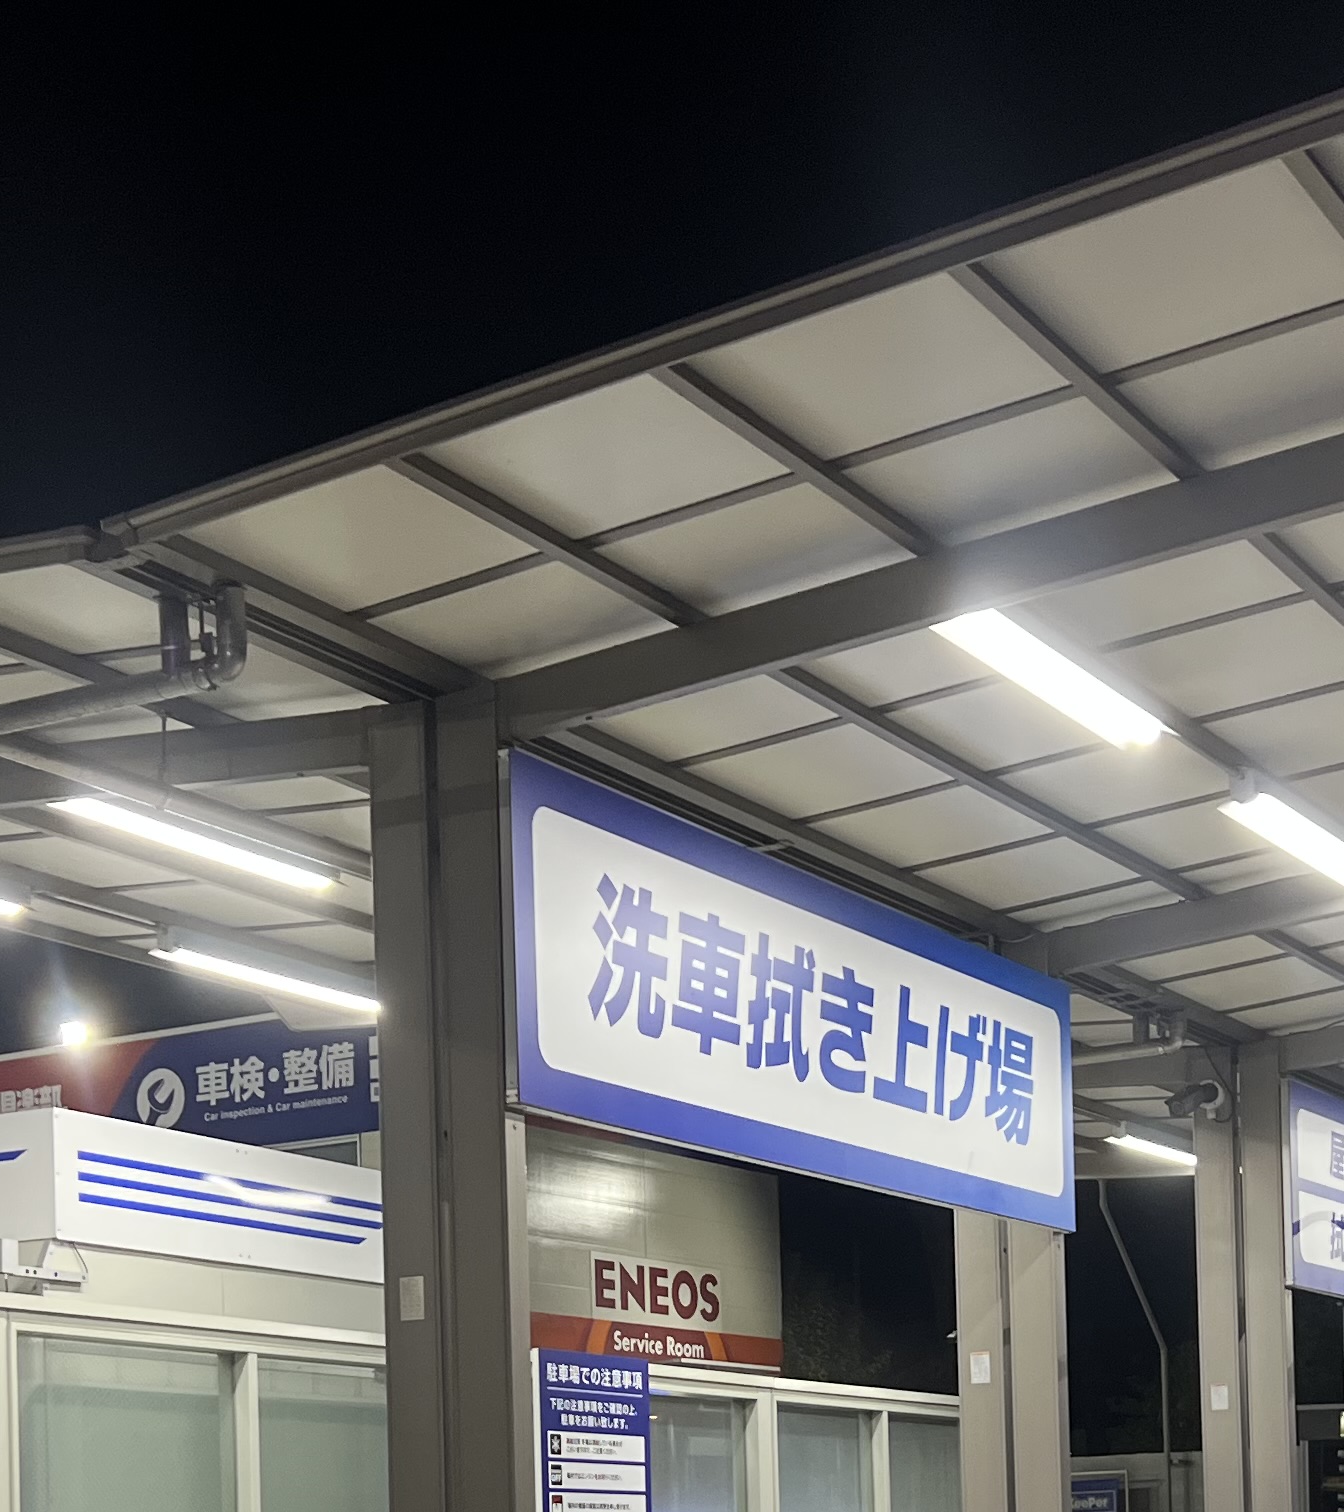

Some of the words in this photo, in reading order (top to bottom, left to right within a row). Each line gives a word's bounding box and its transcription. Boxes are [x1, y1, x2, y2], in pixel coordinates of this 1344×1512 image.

[587, 872, 1035, 1147] 洗車拭き上げ場
[195, 1041, 355, 1106] 車検・整備
[275, 1101, 291, 1112] Car
[594, 1259, 720, 1322] ENEOS
[613, 1330, 663, 1355] Service
[666, 1335, 705, 1358] Room
